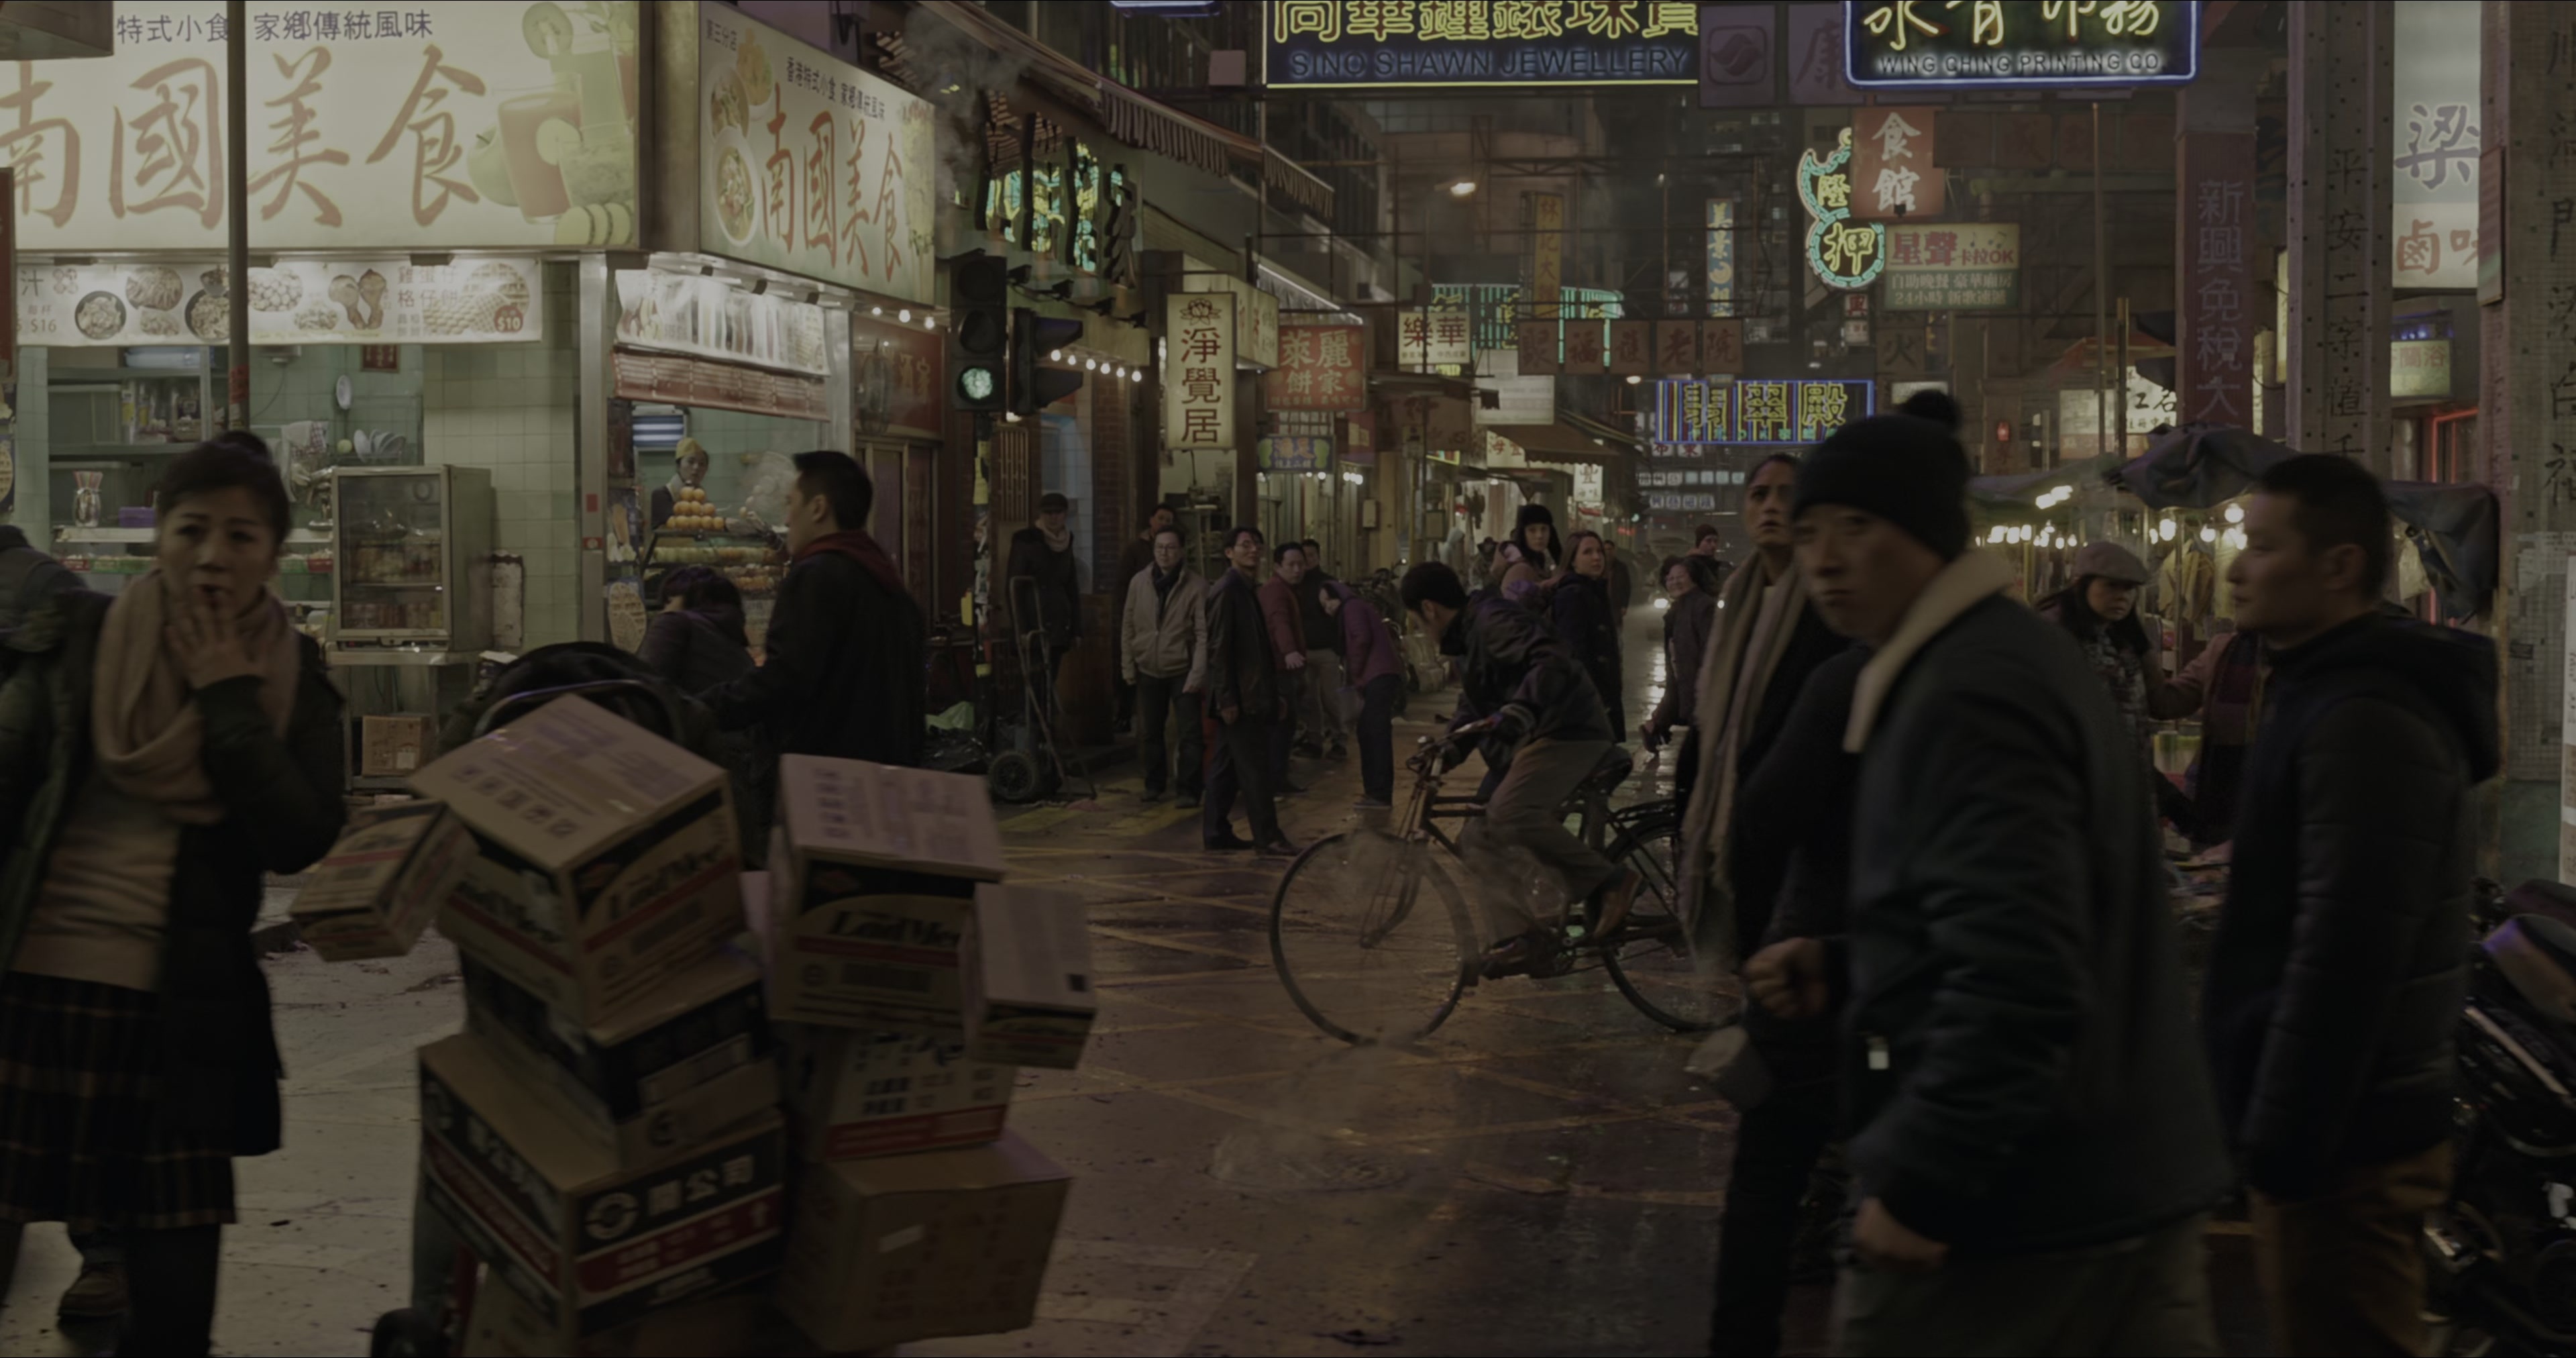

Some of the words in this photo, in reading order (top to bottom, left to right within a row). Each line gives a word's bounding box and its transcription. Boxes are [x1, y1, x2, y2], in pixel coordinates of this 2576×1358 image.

[116, 13, 229, 44] 特式小食
[253, 9, 433, 42] 家鄉傳統風味
[1291, 51, 1366, 76] SINO
[1375, 49, 1491, 75] SHAWN
[1501, 46, 1687, 74] JEWELLERY
[1878, 56, 1936, 74] WING
[1945, 55, 2012, 73] CHING
[2019, 54, 2122, 72] PRINTING
[2129, 53, 2160, 69] CO
[1872, 111, 1923, 213] 食館
[2393, 104, 2480, 190] 梁
[761, 81, 902, 282] 南國美食
[30, 317, 57, 333] $16
[497, 316, 521, 330] $10
[1180, 327, 1222, 443] 淨覺居
[1682, 382, 1849, 427] 翡翠殿
